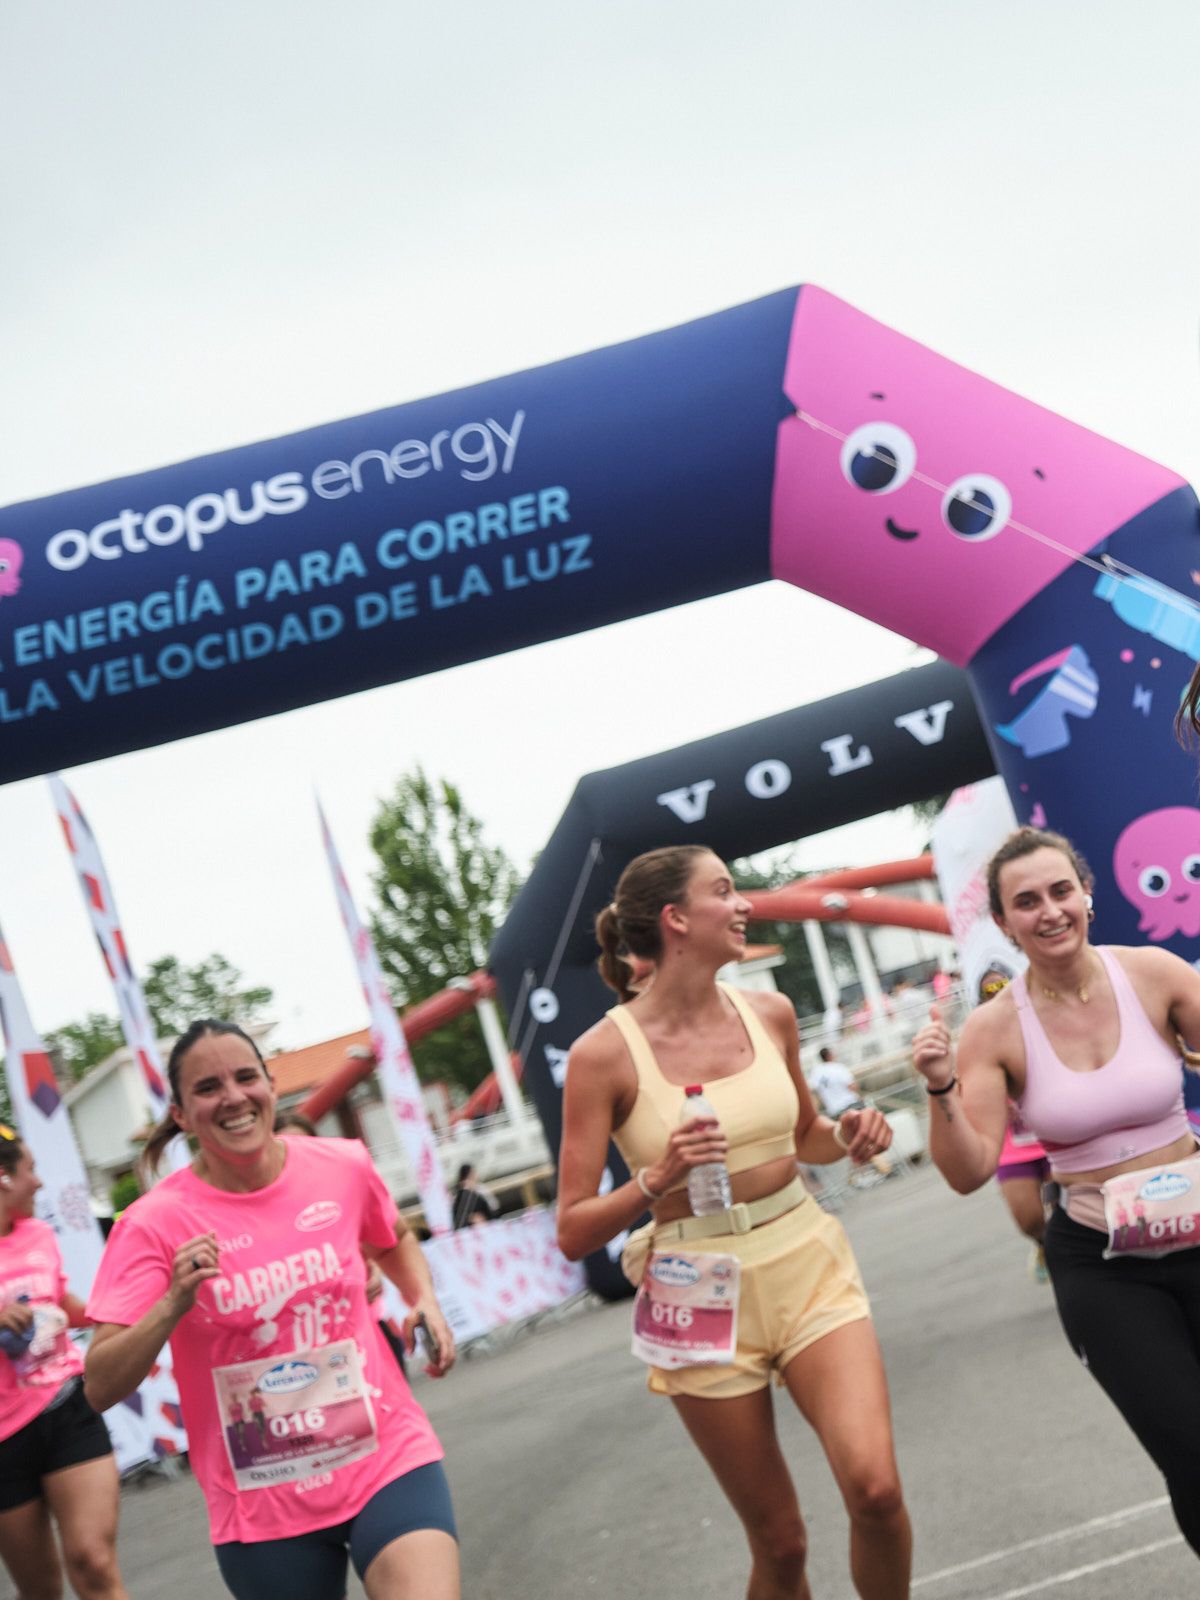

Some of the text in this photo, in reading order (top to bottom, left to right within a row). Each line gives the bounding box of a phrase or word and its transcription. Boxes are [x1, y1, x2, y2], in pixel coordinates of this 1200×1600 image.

[45, 409, 526, 571] octopus energy
[14, 485, 571, 667] ENERGÍA PARA CORRER
[0, 534, 595, 724] LA VELOCIDAD DE LA LUZ
[656, 700, 955, 824] VOLV
[1149, 1215, 1196, 1238] 016
[212, 1242, 341, 1316] CARRERA
[651, 1303, 694, 1328] 016
[269, 1407, 326, 1438] 016
